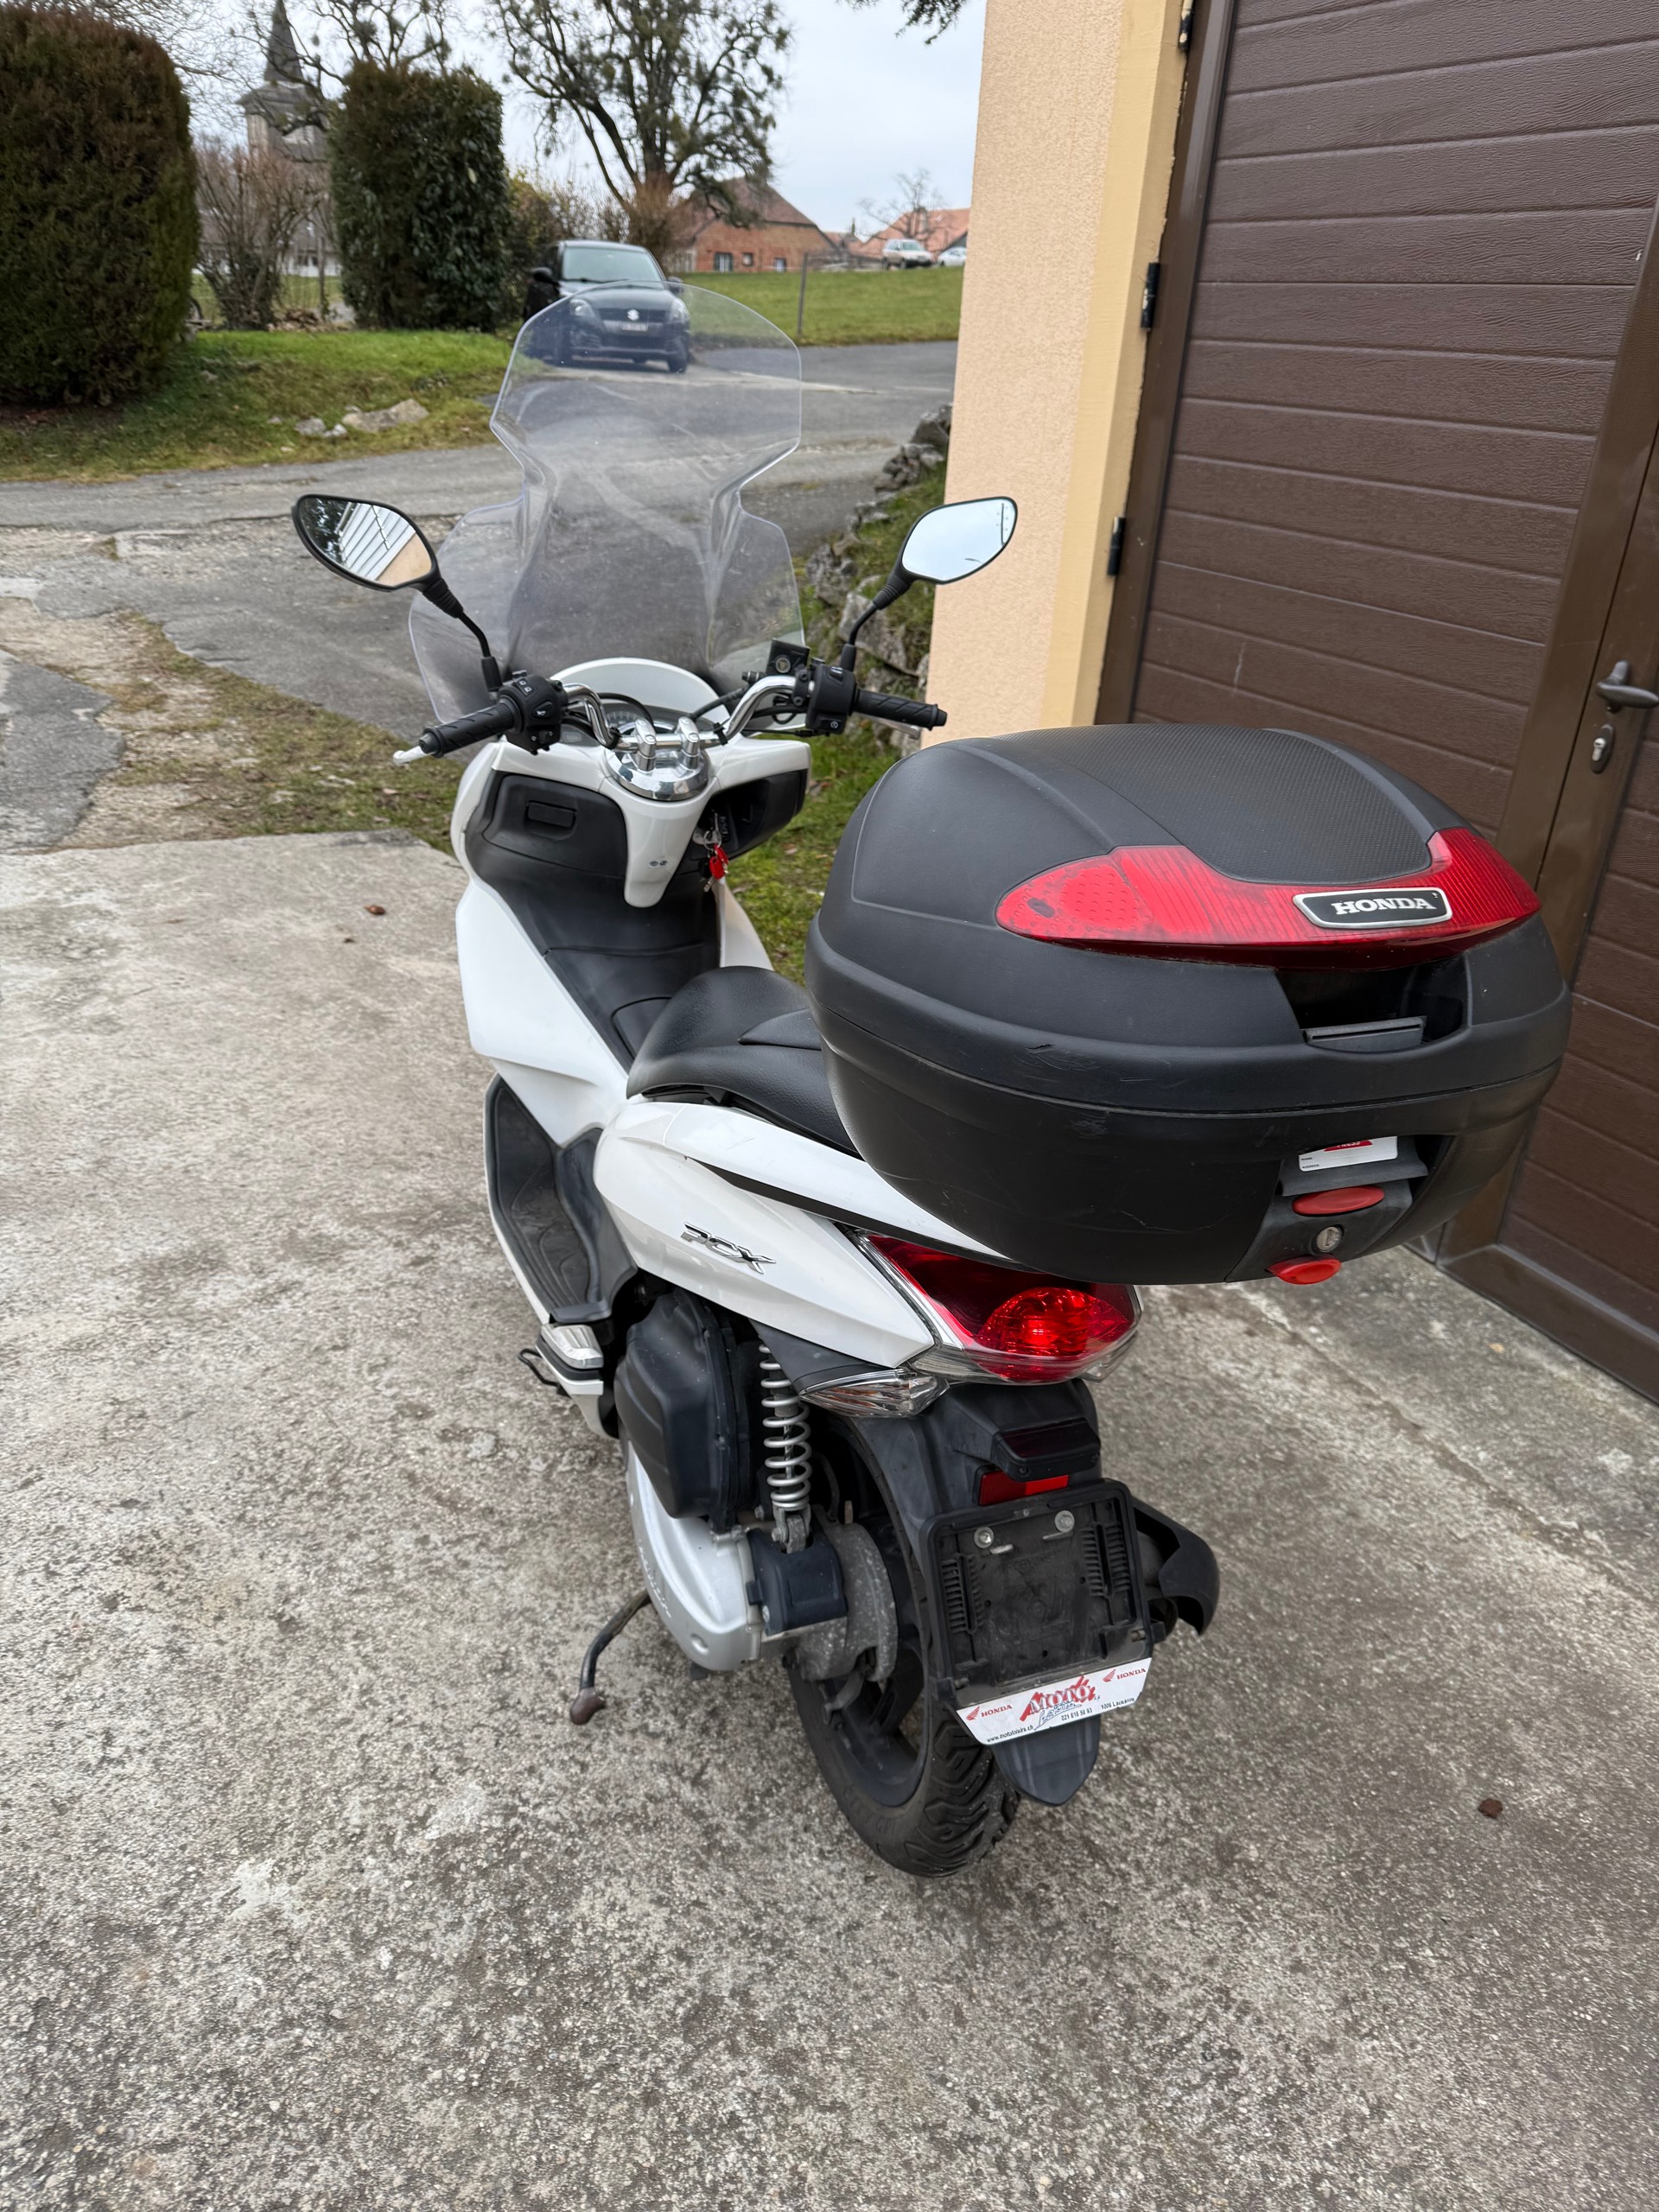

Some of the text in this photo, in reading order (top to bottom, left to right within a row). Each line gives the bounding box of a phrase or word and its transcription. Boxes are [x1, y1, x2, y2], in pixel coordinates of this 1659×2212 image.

[1332, 898, 1436, 915] HONDA
[680, 1222, 777, 1274] PCX
[1116, 1668, 1147, 1681] HONDA
[1029, 1686, 1090, 1714] MOTO
[981, 1704, 1013, 1718] HONDA
